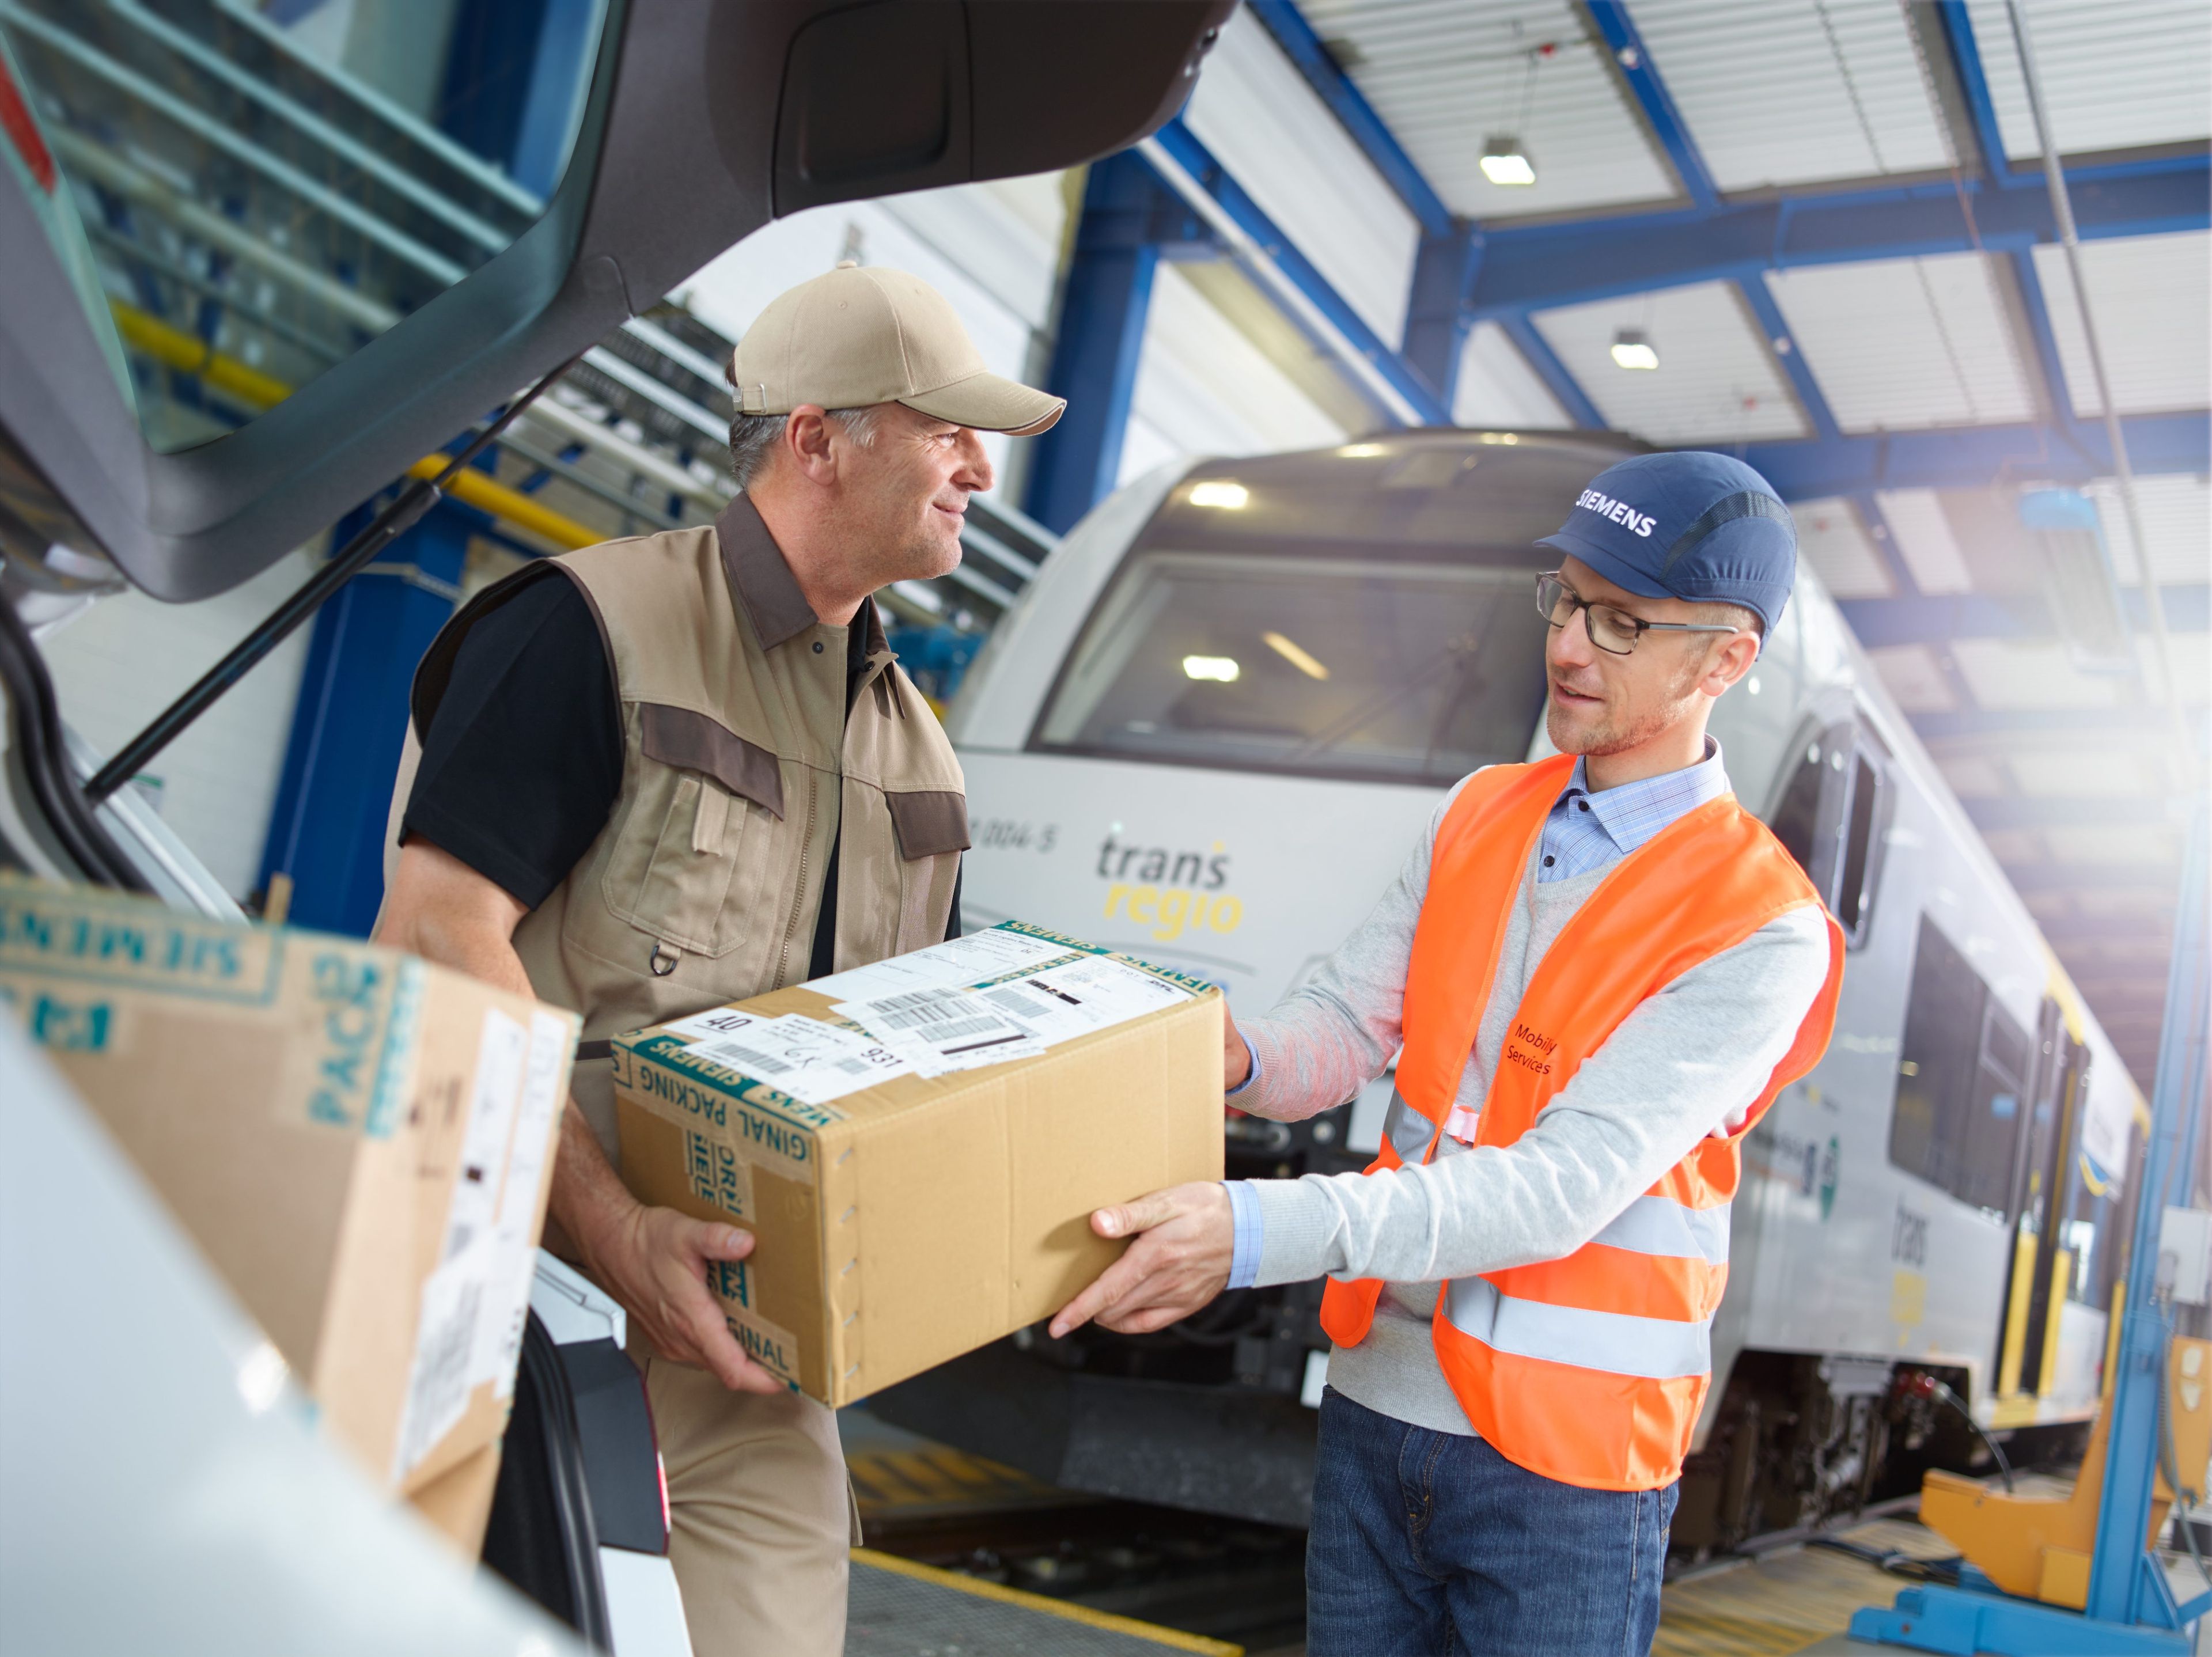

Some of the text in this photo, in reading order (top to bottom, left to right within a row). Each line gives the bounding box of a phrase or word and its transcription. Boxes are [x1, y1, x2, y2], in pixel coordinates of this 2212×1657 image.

[1575, 488, 1657, 538] SIEMENS
[1096, 835, 1230, 891] trans
[1103, 881, 1245, 942] regio
[706, 1015, 753, 1031] 40
[860, 1047, 904, 1069] 931
[1507, 1045, 1551, 1075] Services
[639, 1065, 728, 1127] PACKING
